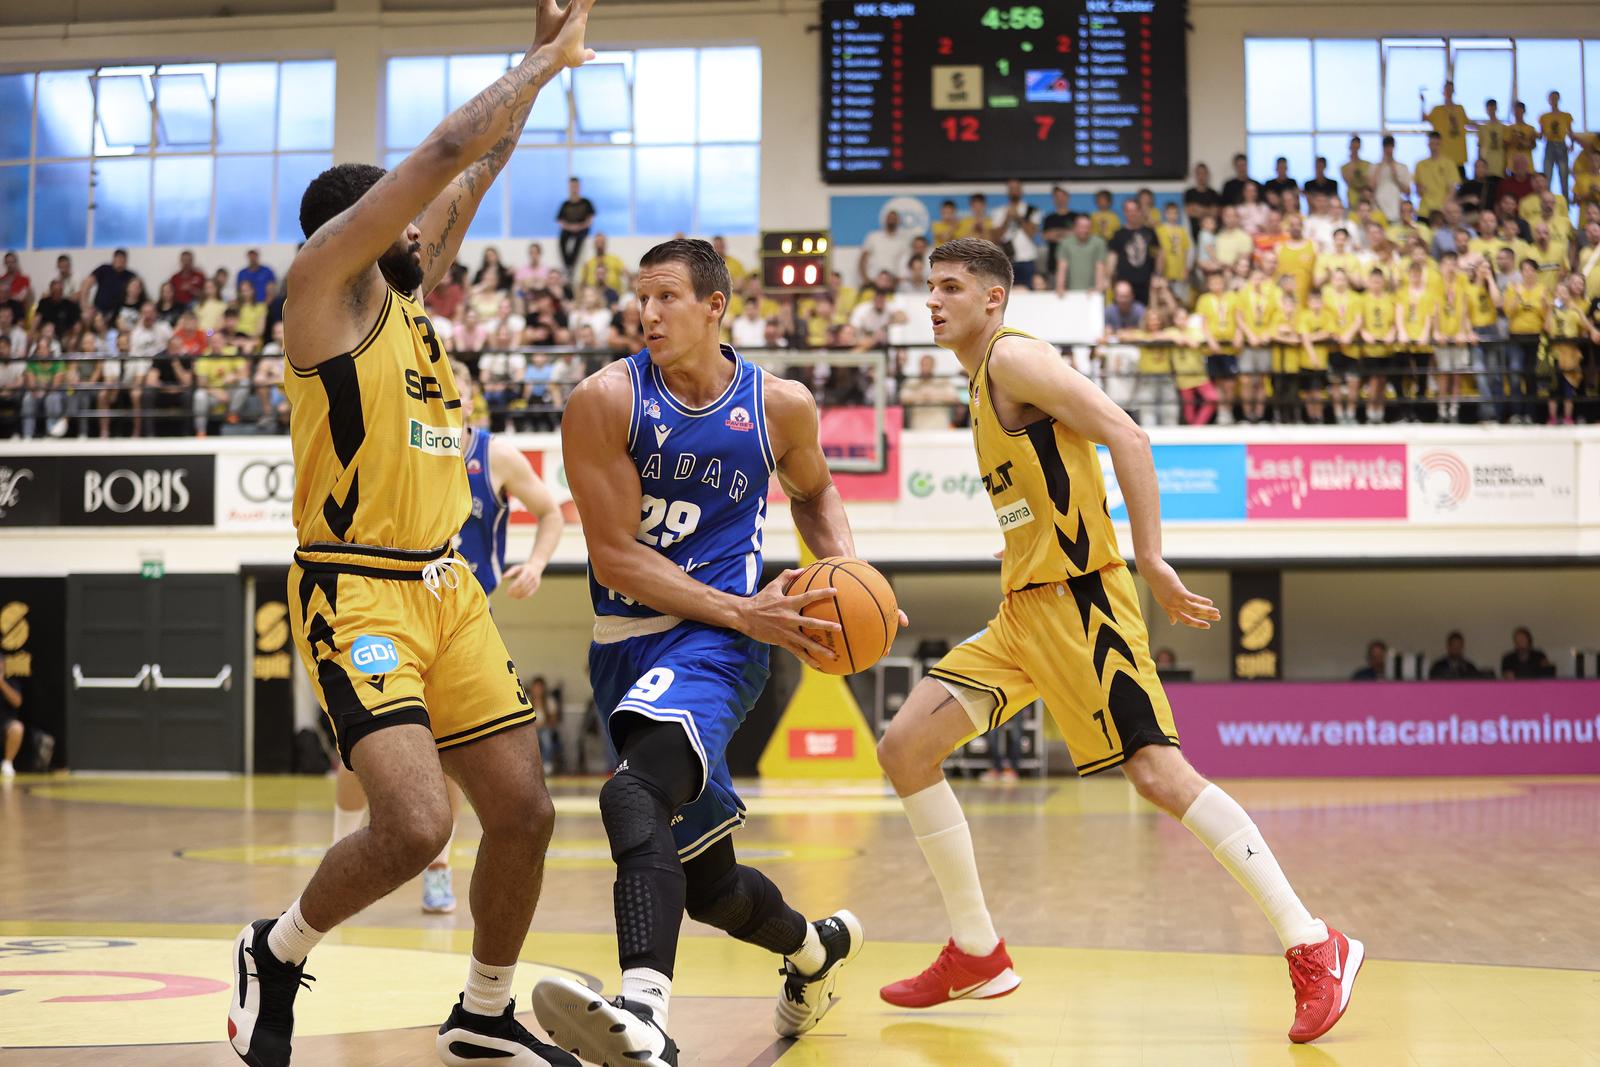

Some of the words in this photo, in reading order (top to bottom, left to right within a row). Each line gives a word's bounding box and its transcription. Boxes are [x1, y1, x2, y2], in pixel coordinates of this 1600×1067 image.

[981, 7, 1044, 29] 4:56
[938, 37, 953, 54] 2
[1056, 35, 1071, 52] 2
[942, 116, 980, 141] 12
[1034, 115, 1055, 140] 7
[425, 431, 460, 449] Grou
[634, 453, 749, 502] ADAR
[1247, 456, 1303, 480] Last
[84, 468, 190, 513] BOBIS
[636, 494, 701, 548] 29
[997, 506, 1031, 527] pama
[353, 644, 396, 665] GDi
